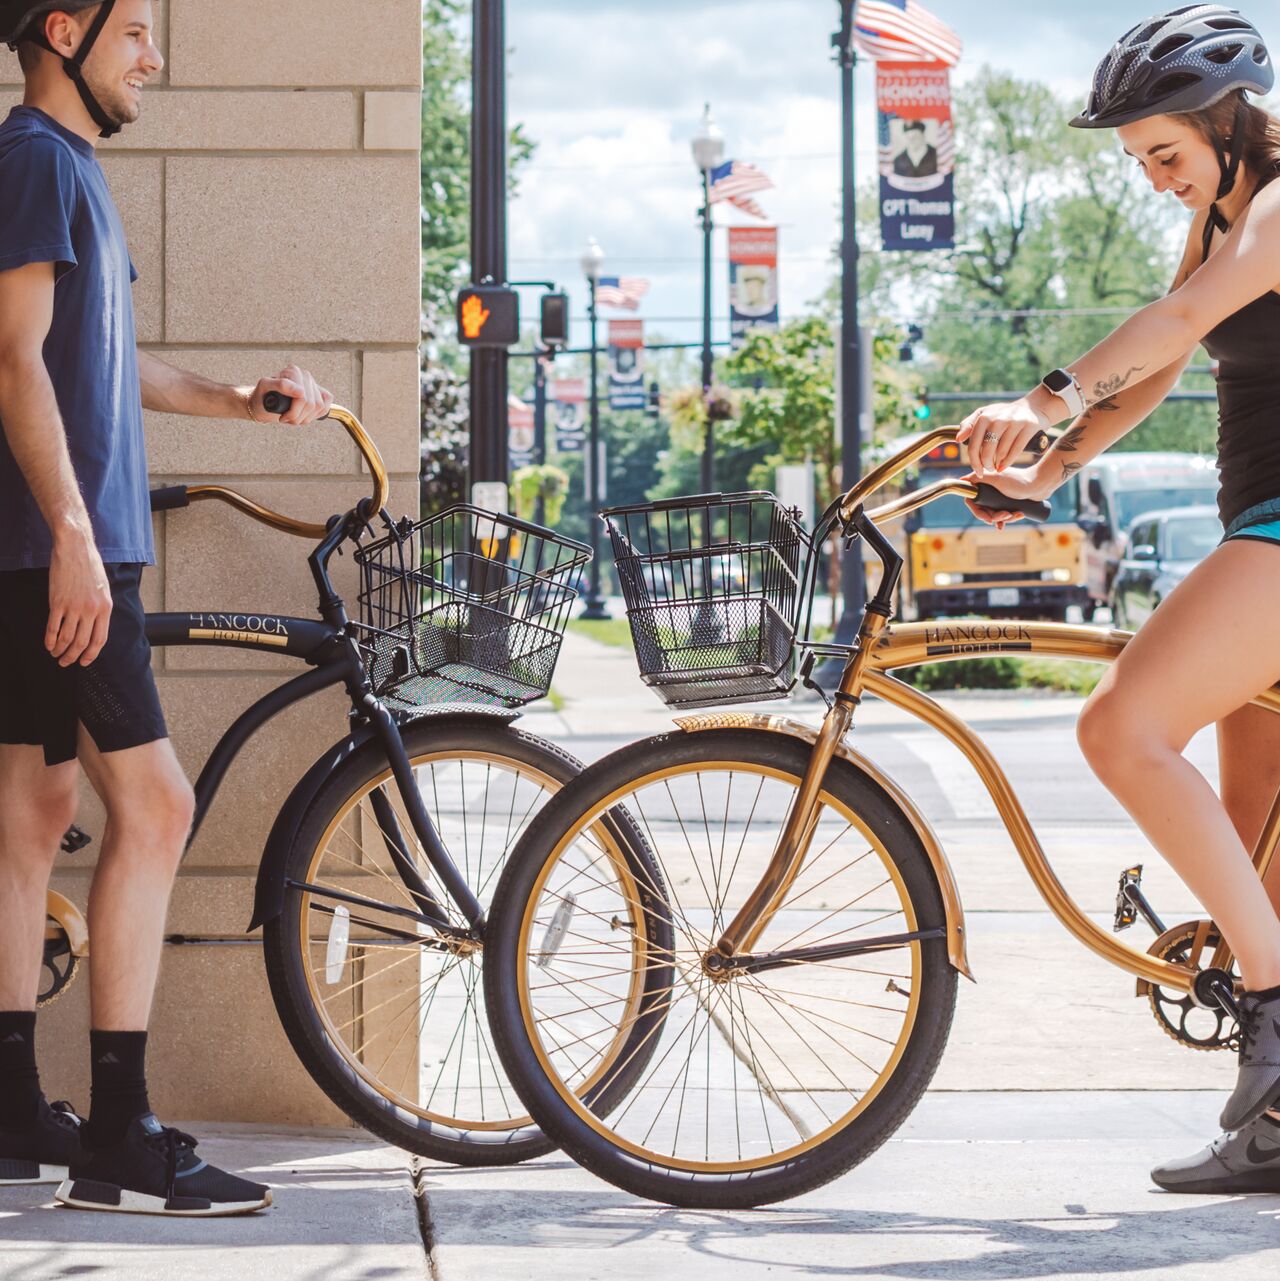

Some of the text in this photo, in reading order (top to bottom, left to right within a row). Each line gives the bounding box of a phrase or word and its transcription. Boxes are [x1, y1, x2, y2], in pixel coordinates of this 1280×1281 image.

[190, 613, 289, 634] HANCOCK
[213, 631, 262, 643] HOTEL
[925, 624, 1032, 644] HANCOCK
[951, 643, 1005, 654] HOTEL
